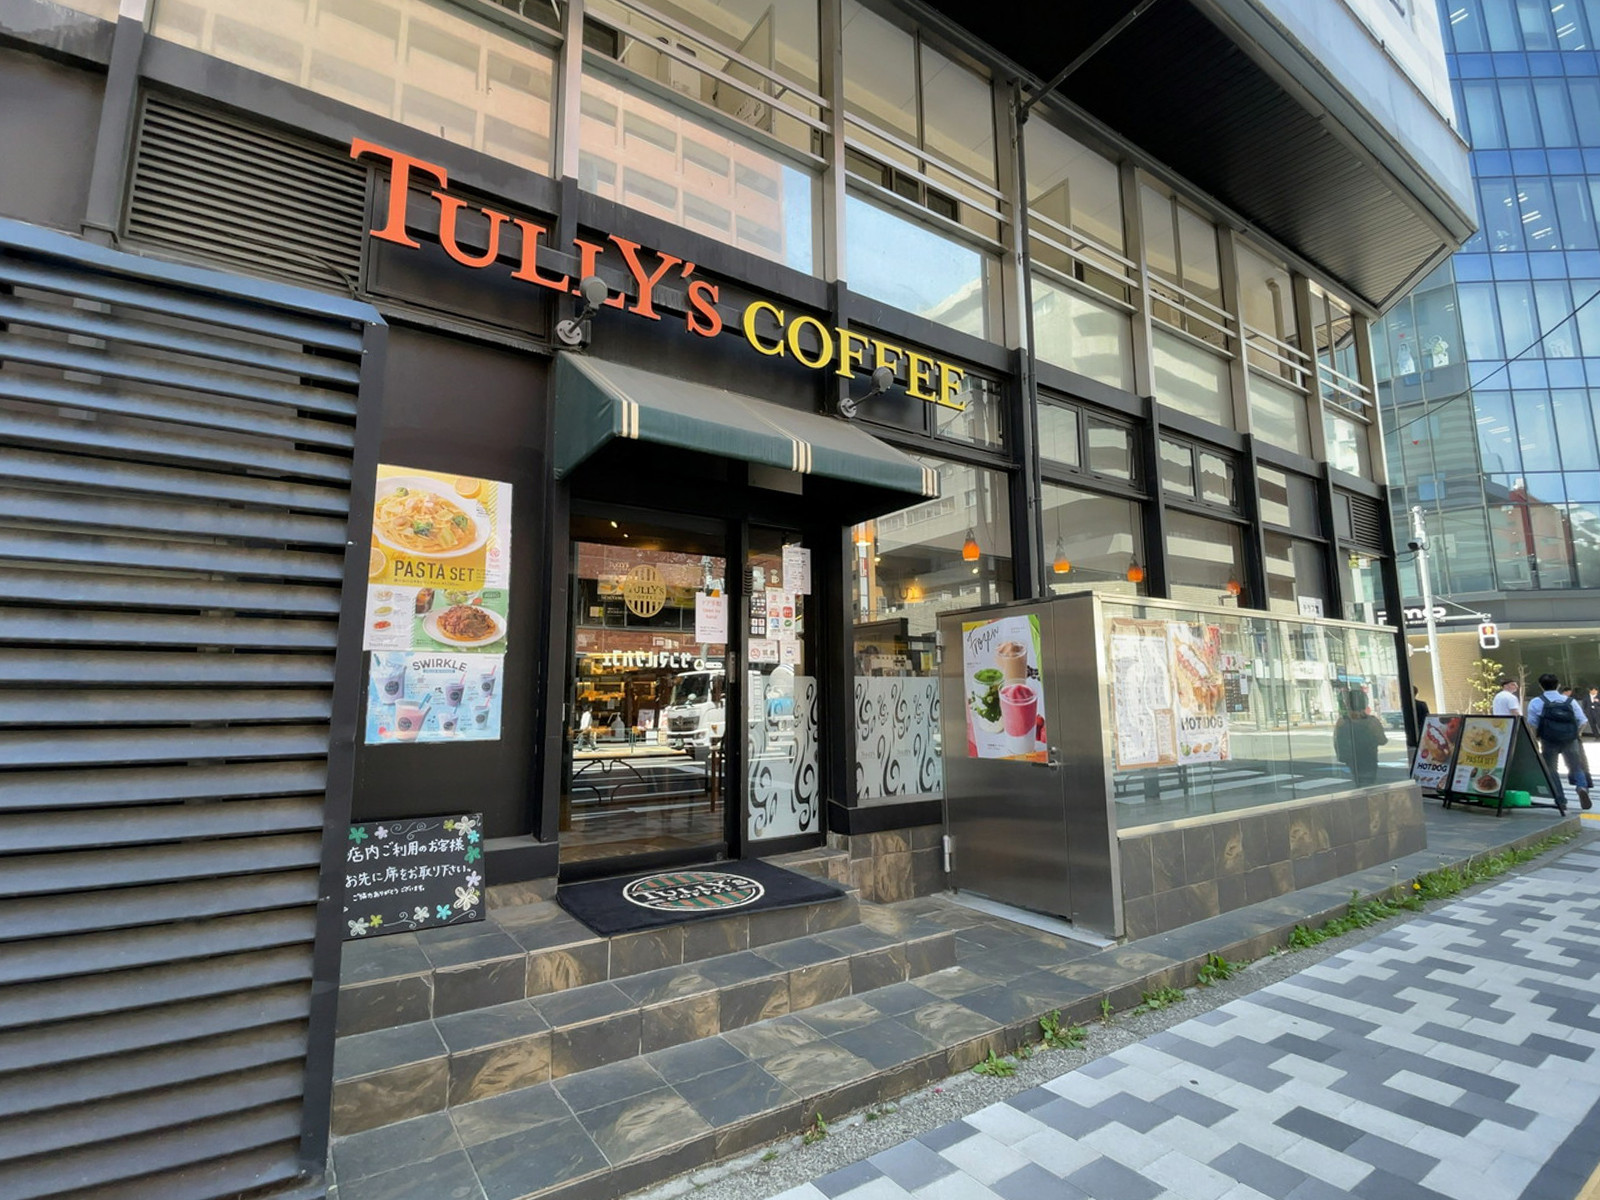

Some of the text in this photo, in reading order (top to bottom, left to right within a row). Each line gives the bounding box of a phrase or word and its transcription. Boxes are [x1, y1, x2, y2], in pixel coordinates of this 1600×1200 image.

[350, 137, 967, 412] TULLY'S COFFEE
[394, 560, 446, 579] PASTA
[449, 567, 475, 582] SET
[412, 658, 468, 673] SWIRKLE
[1417, 762, 1447, 772] HOT DOG
[1466, 755, 1484, 764] PASTA
[347, 837, 464, 863] 店内ご利用のお客様
[632, 879, 747, 900] TULLY'S
